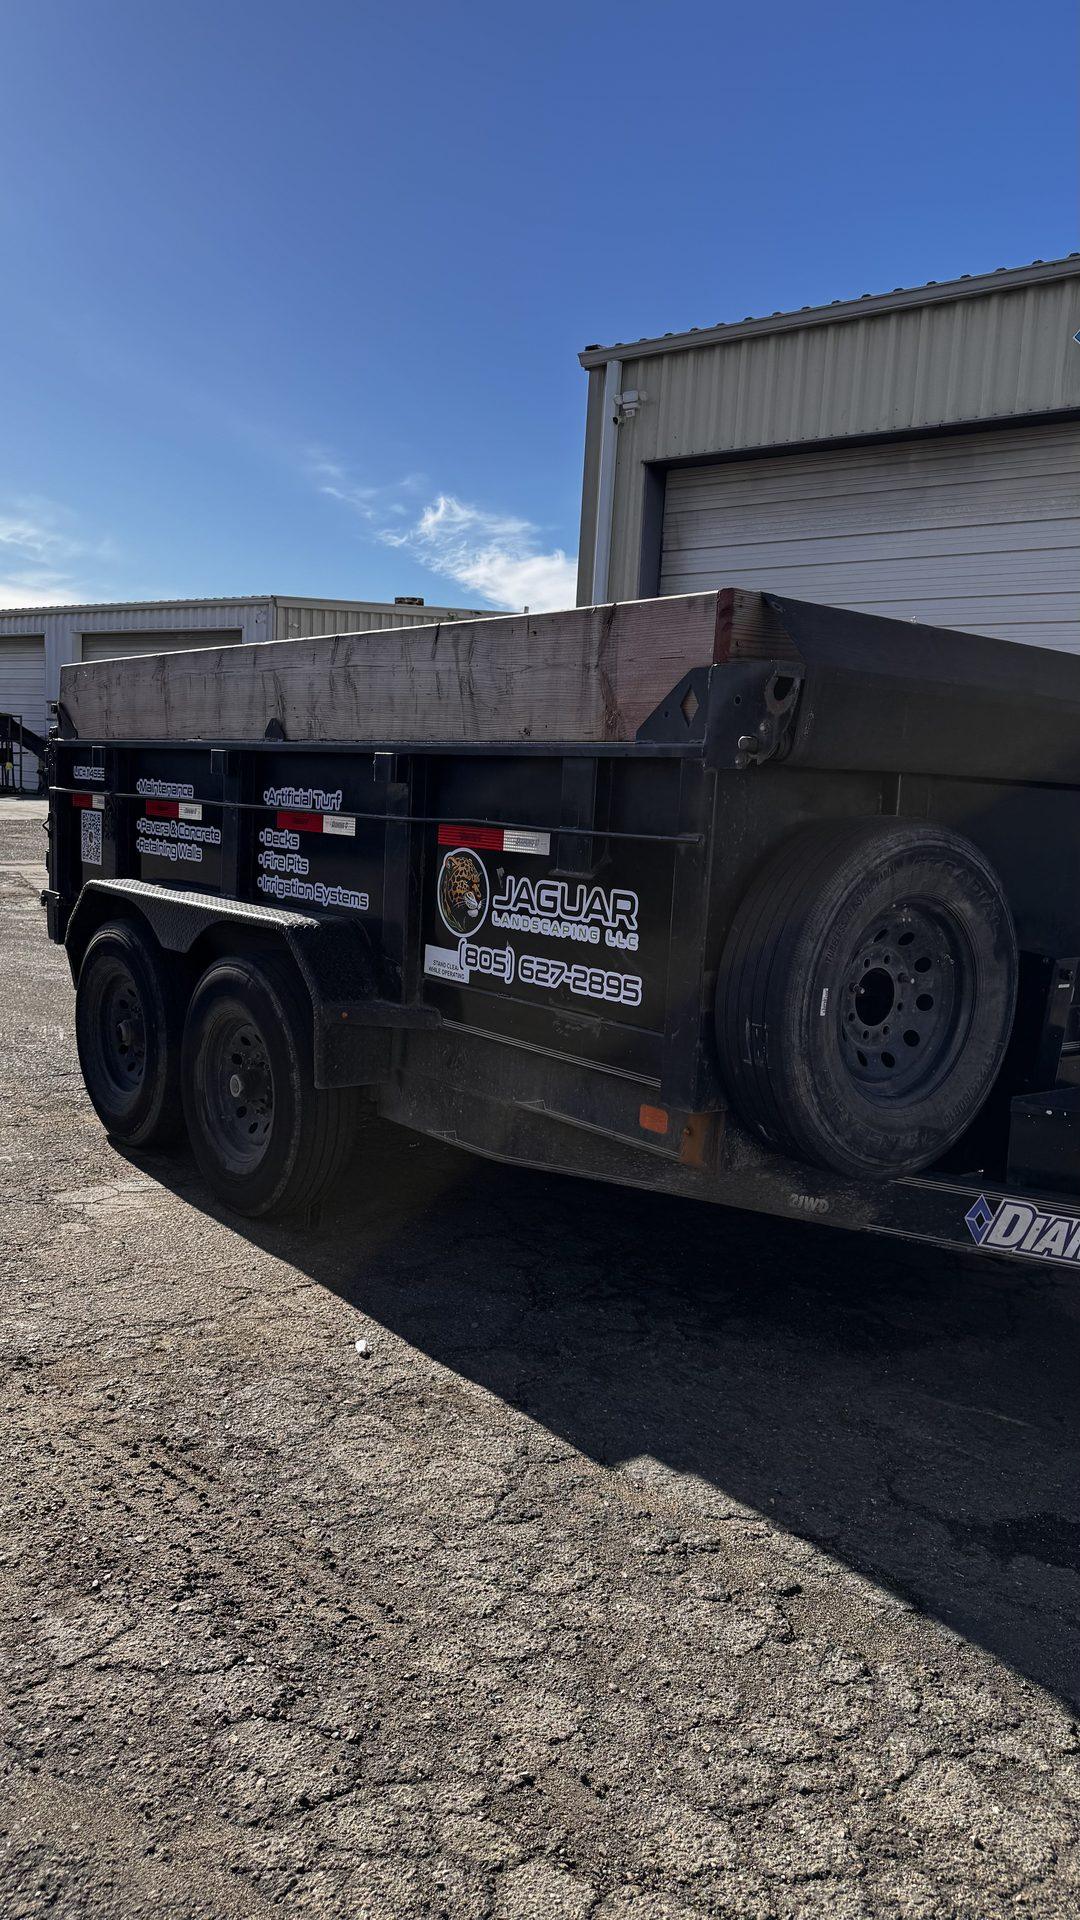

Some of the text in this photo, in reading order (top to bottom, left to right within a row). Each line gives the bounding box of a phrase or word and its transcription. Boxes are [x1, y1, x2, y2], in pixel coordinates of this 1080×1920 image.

[139, 778, 194, 798] Maintenance
[265, 787, 343, 811] Artificial Turf
[139, 818, 221, 844] Pavers & Concrete
[264, 828, 300, 850] Decks
[139, 837, 203, 862] Retaining Walls
[263, 851, 310, 875] Fire Pits
[261, 873, 370, 911] Irrigation Systems
[493, 875, 639, 930] JAGUAR
[491, 910, 639, 951] LANDSCAPING LLC
[458, 938, 643, 1007] (805) 627-2895
